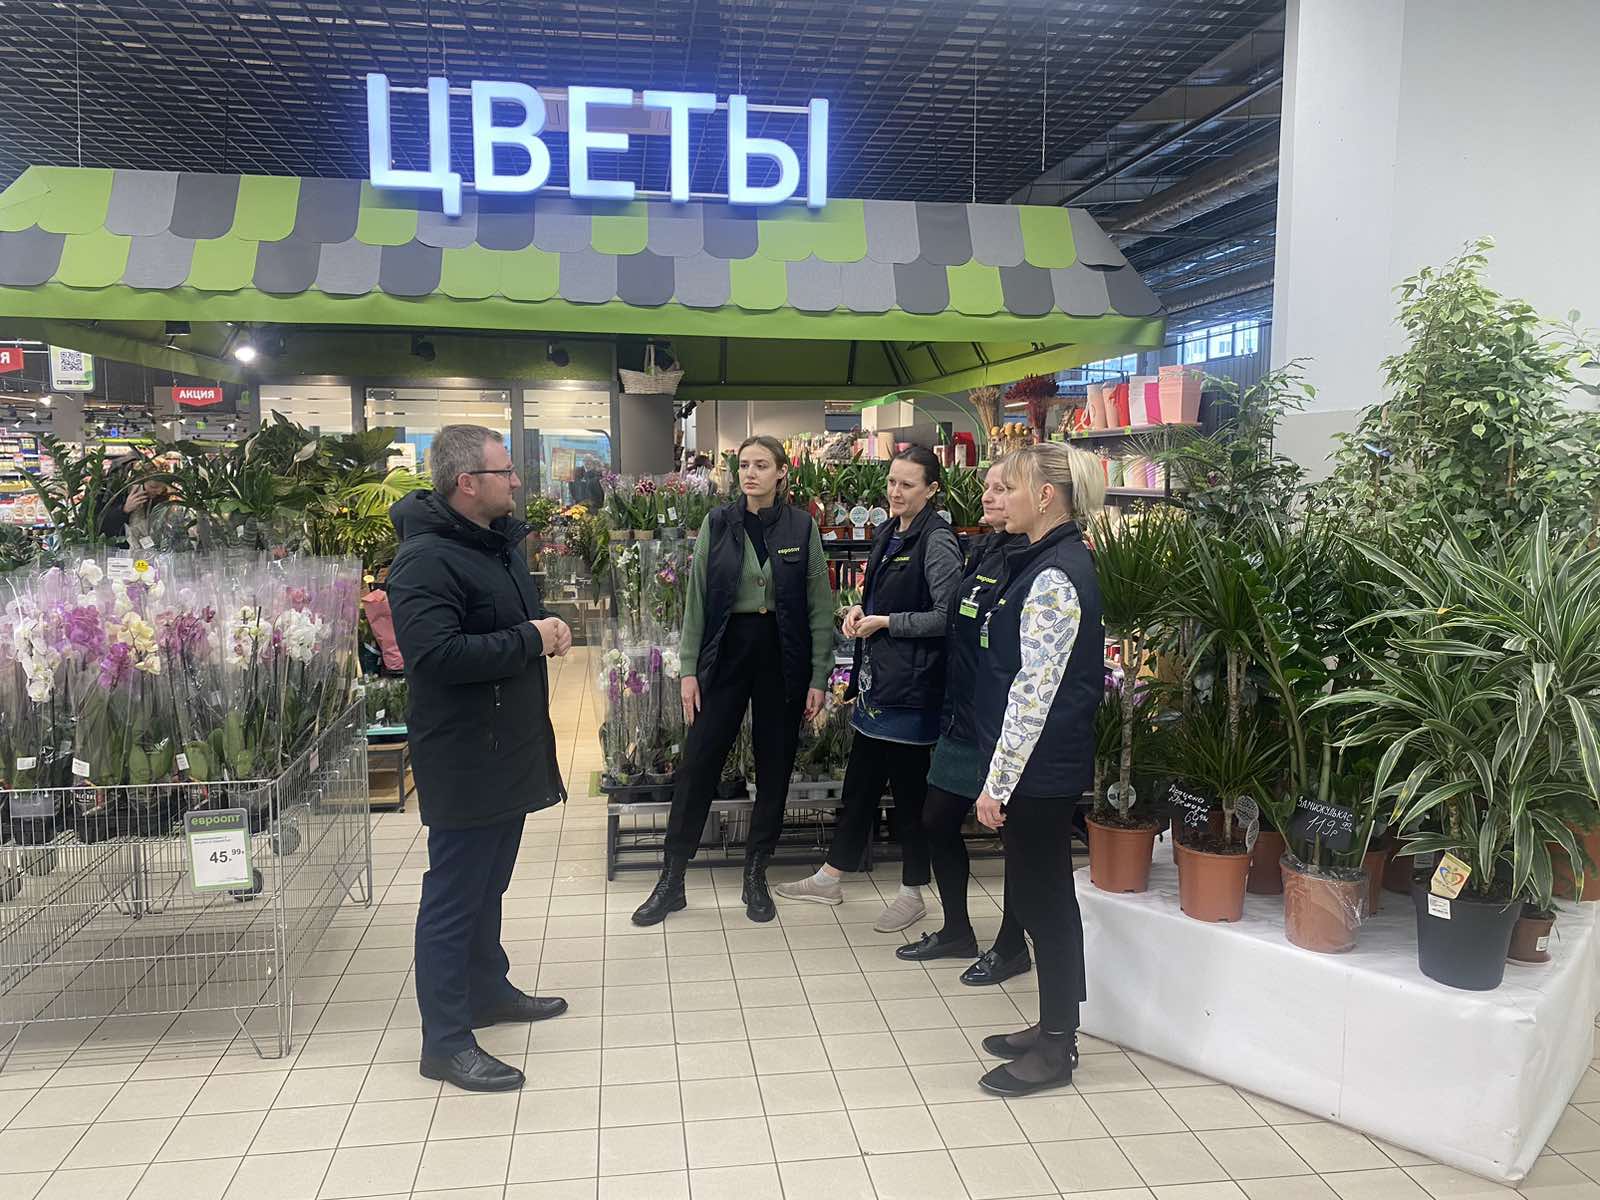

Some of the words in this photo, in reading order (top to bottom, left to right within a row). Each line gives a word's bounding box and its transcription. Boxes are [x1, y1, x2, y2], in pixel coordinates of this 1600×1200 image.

[366, 73, 829, 216] ЦВЕТЫ
[179, 390, 215, 400] АКЦИЯ
[191, 814, 241, 826] евроопт
